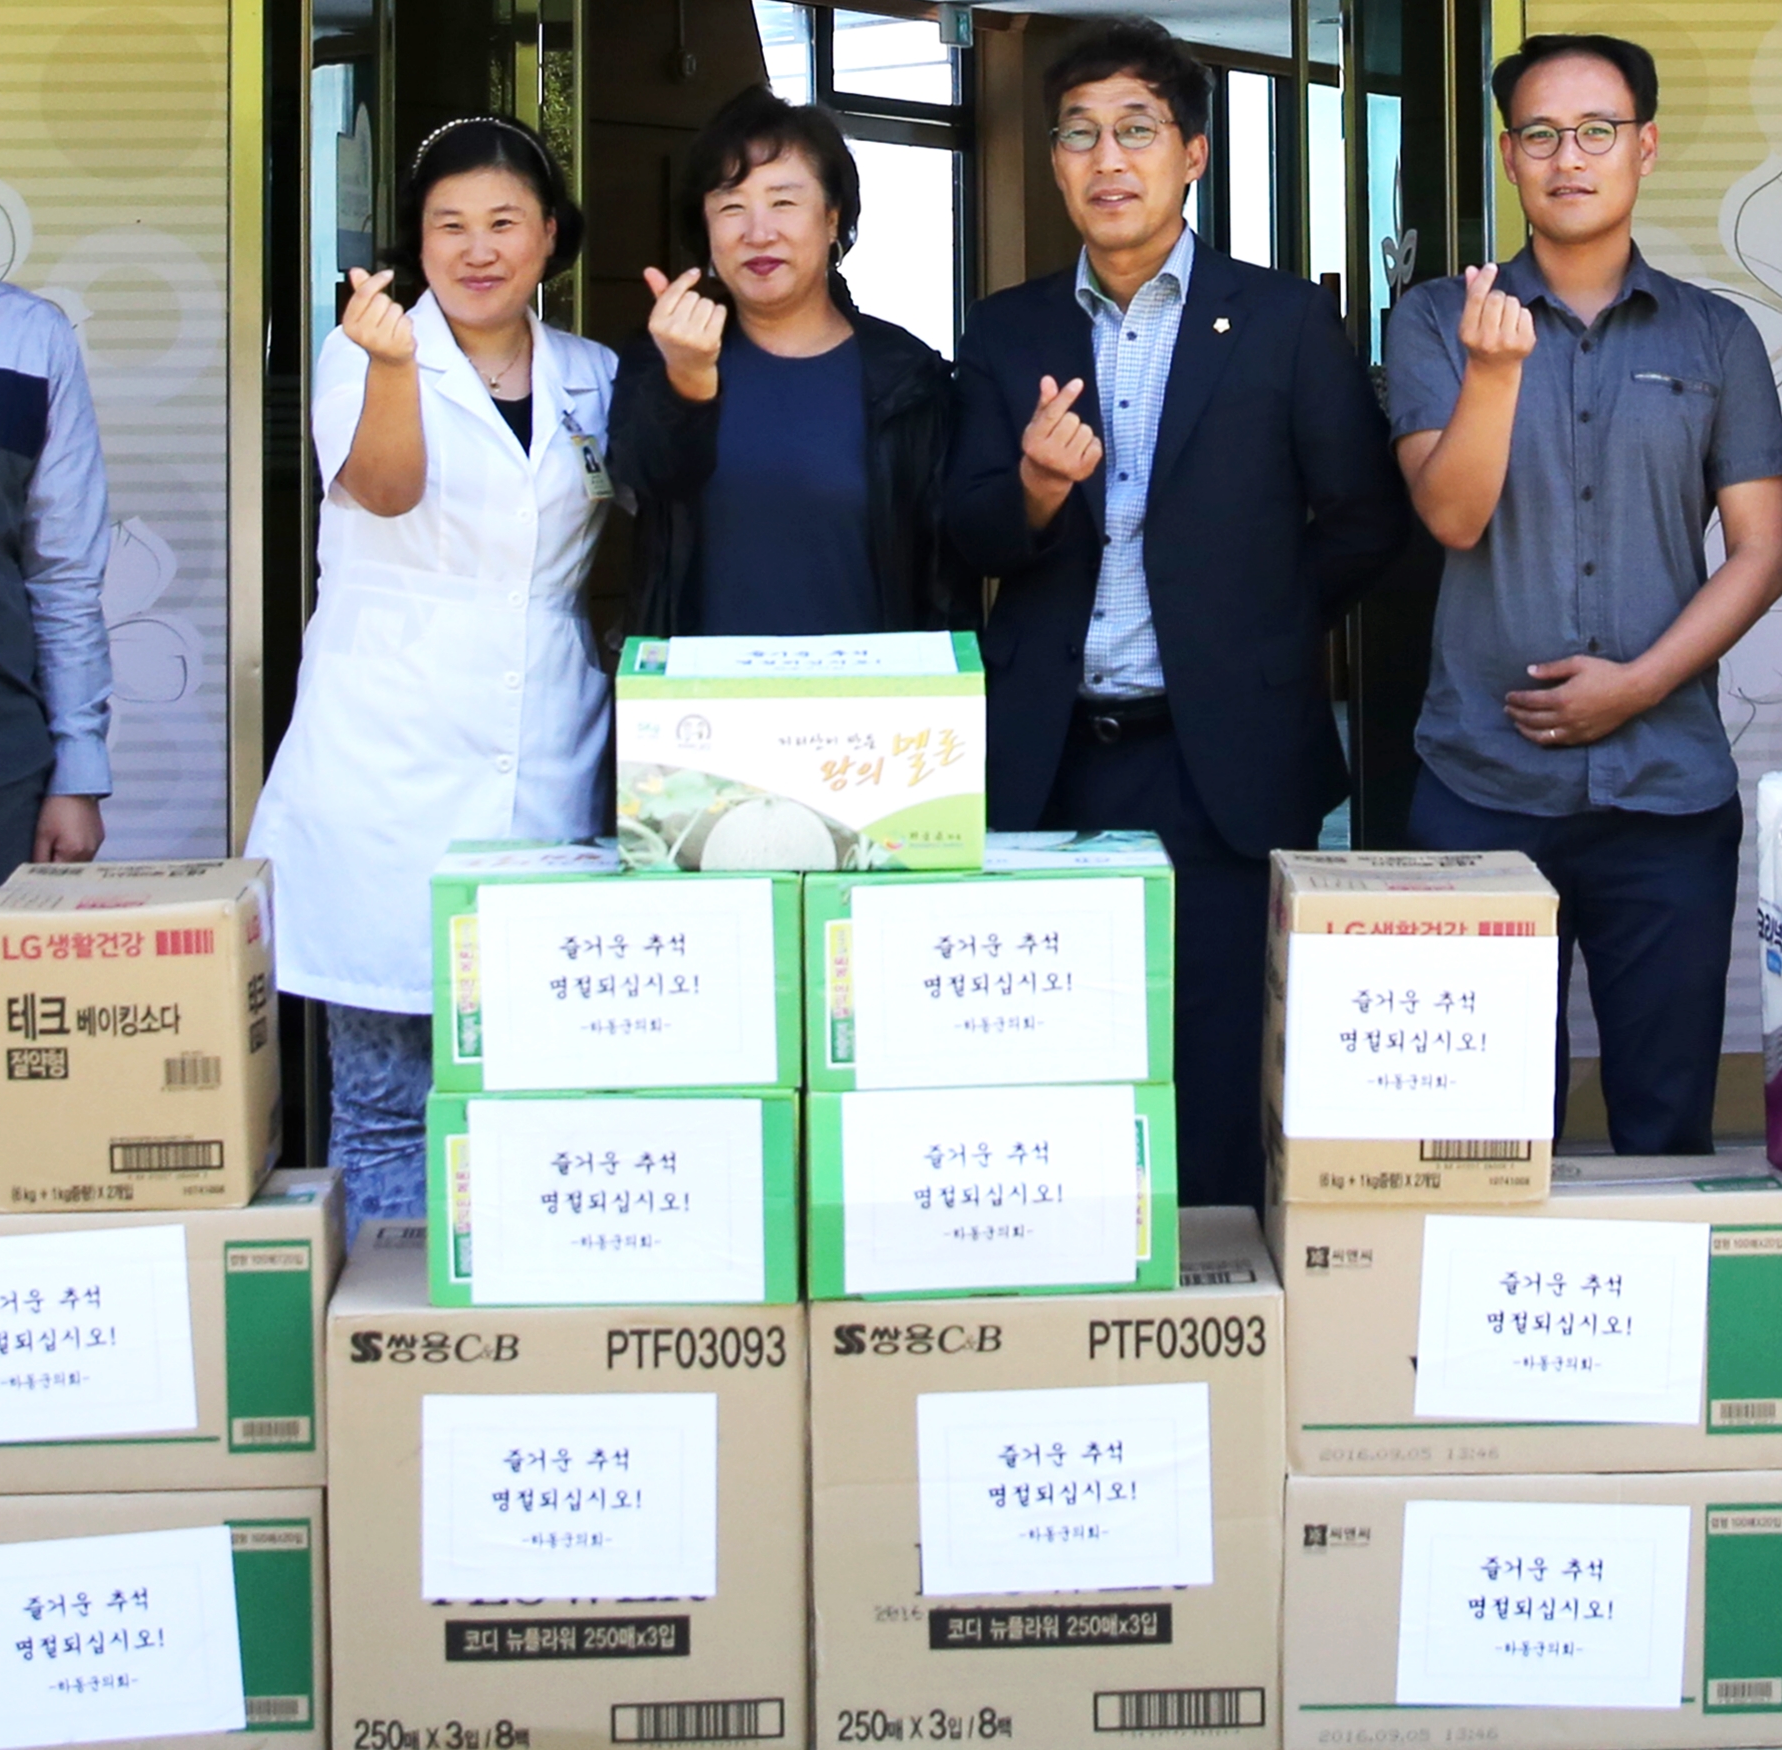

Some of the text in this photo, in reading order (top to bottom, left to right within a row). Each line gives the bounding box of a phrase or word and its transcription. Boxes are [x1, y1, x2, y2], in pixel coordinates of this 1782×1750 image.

[820, 755, 885, 792] 왕의
[560, 934, 685, 960] 즐거운 추석
[934, 932, 1058, 959] 즐거운 추석
[550, 973, 698, 1000] 명절되십시오!
[924, 971, 1071, 998] 명절되십시오!
[1352, 990, 1475, 1014] 즐거운 추석
[7, 993, 180, 1040] 테크 베이킹소다
[1340, 1029, 1486, 1053] 명절되십시오!
[10, 1049, 68, 1079] 절약형
[551, 1151, 676, 1176] 즐거운 추석
[924, 1141, 1048, 1169] 즐거운 추석
[541, 1190, 689, 1214] 명절되십시오!
[914, 1183, 1062, 1210] 명절되십시오!
[60, 1286, 100, 1309] 추석
[1500, 1272, 1622, 1297] 즐거운 추석
[1487, 1310, 1631, 1336] 명절되십시오!
[607, 1325, 786, 1370] PTF03093
[1089, 1315, 1266, 1360] PTF03093
[504, 1448, 629, 1473] 즐거운 추석
[999, 1441, 1122, 1469] 즐거운 추석
[492, 1488, 641, 1512] 명절되십시오!
[989, 1480, 1135, 1508] 명절되십시오!
[1481, 1557, 1603, 1582] 즐거운 추석
[23, 1588, 148, 1621] 즐거운 추석
[1469, 1596, 1613, 1620] 명절되십시오!
[463, 1629, 499, 1652] 코디
[947, 1617, 982, 1641] 코디
[15, 1628, 164, 1661] 명절되십시오!
[445, 1721, 479, 1749] 3입
[838, 1709, 903, 1742] 250매
[928, 1708, 963, 1741] 3입
